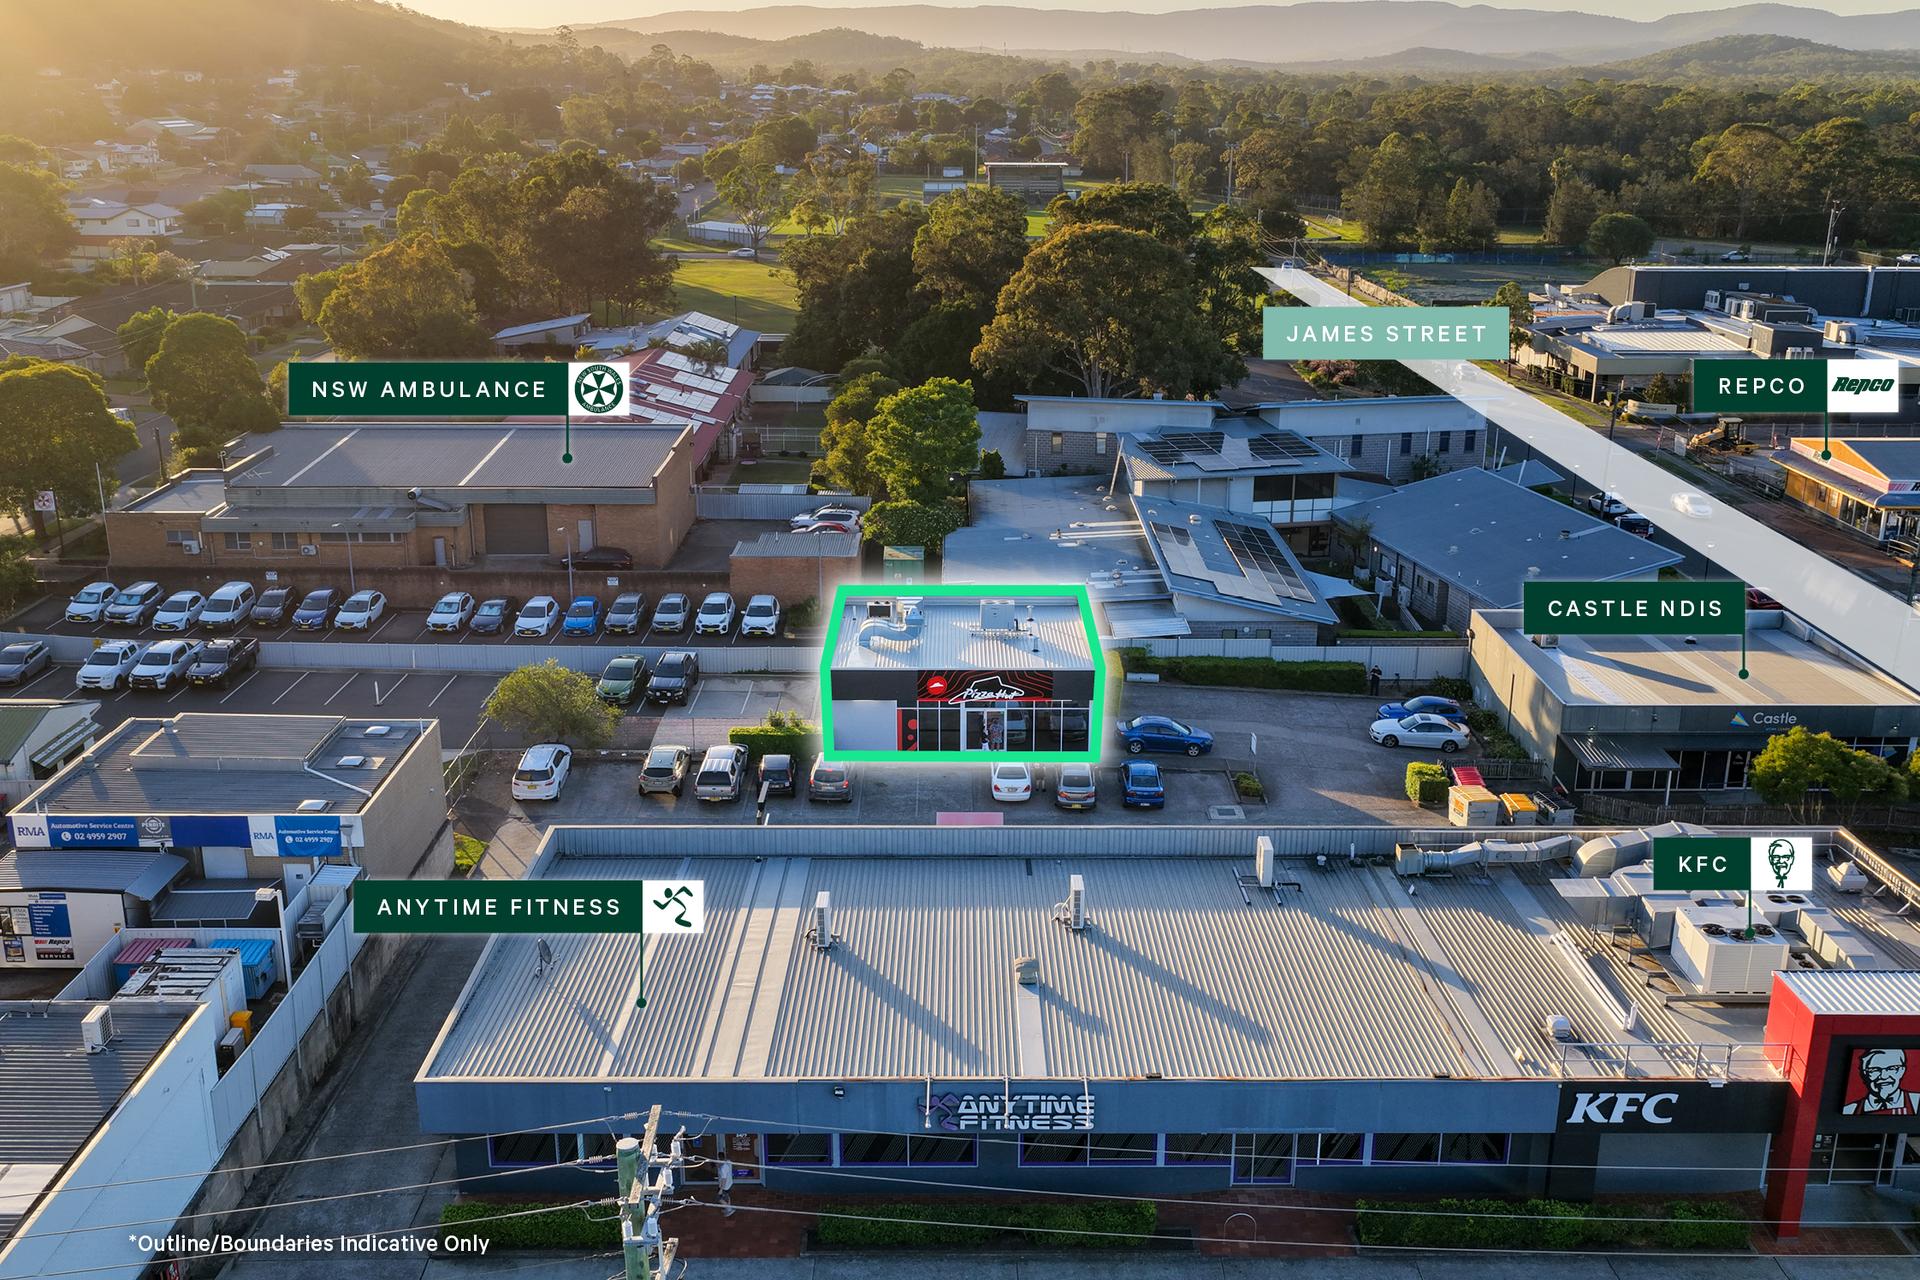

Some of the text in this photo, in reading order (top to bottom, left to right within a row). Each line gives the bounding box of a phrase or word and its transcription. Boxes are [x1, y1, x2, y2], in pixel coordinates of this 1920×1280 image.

[963, 688, 994, 699] Pizza
[1753, 712, 1797, 724] Castle
[17, 827, 45, 836] RMA
[253, 832, 274, 840] RMA
[957, 1095, 1095, 1114] ANYTIME
[1566, 1092, 1679, 1124] KFC
[959, 1115, 1095, 1130] FITNESS
